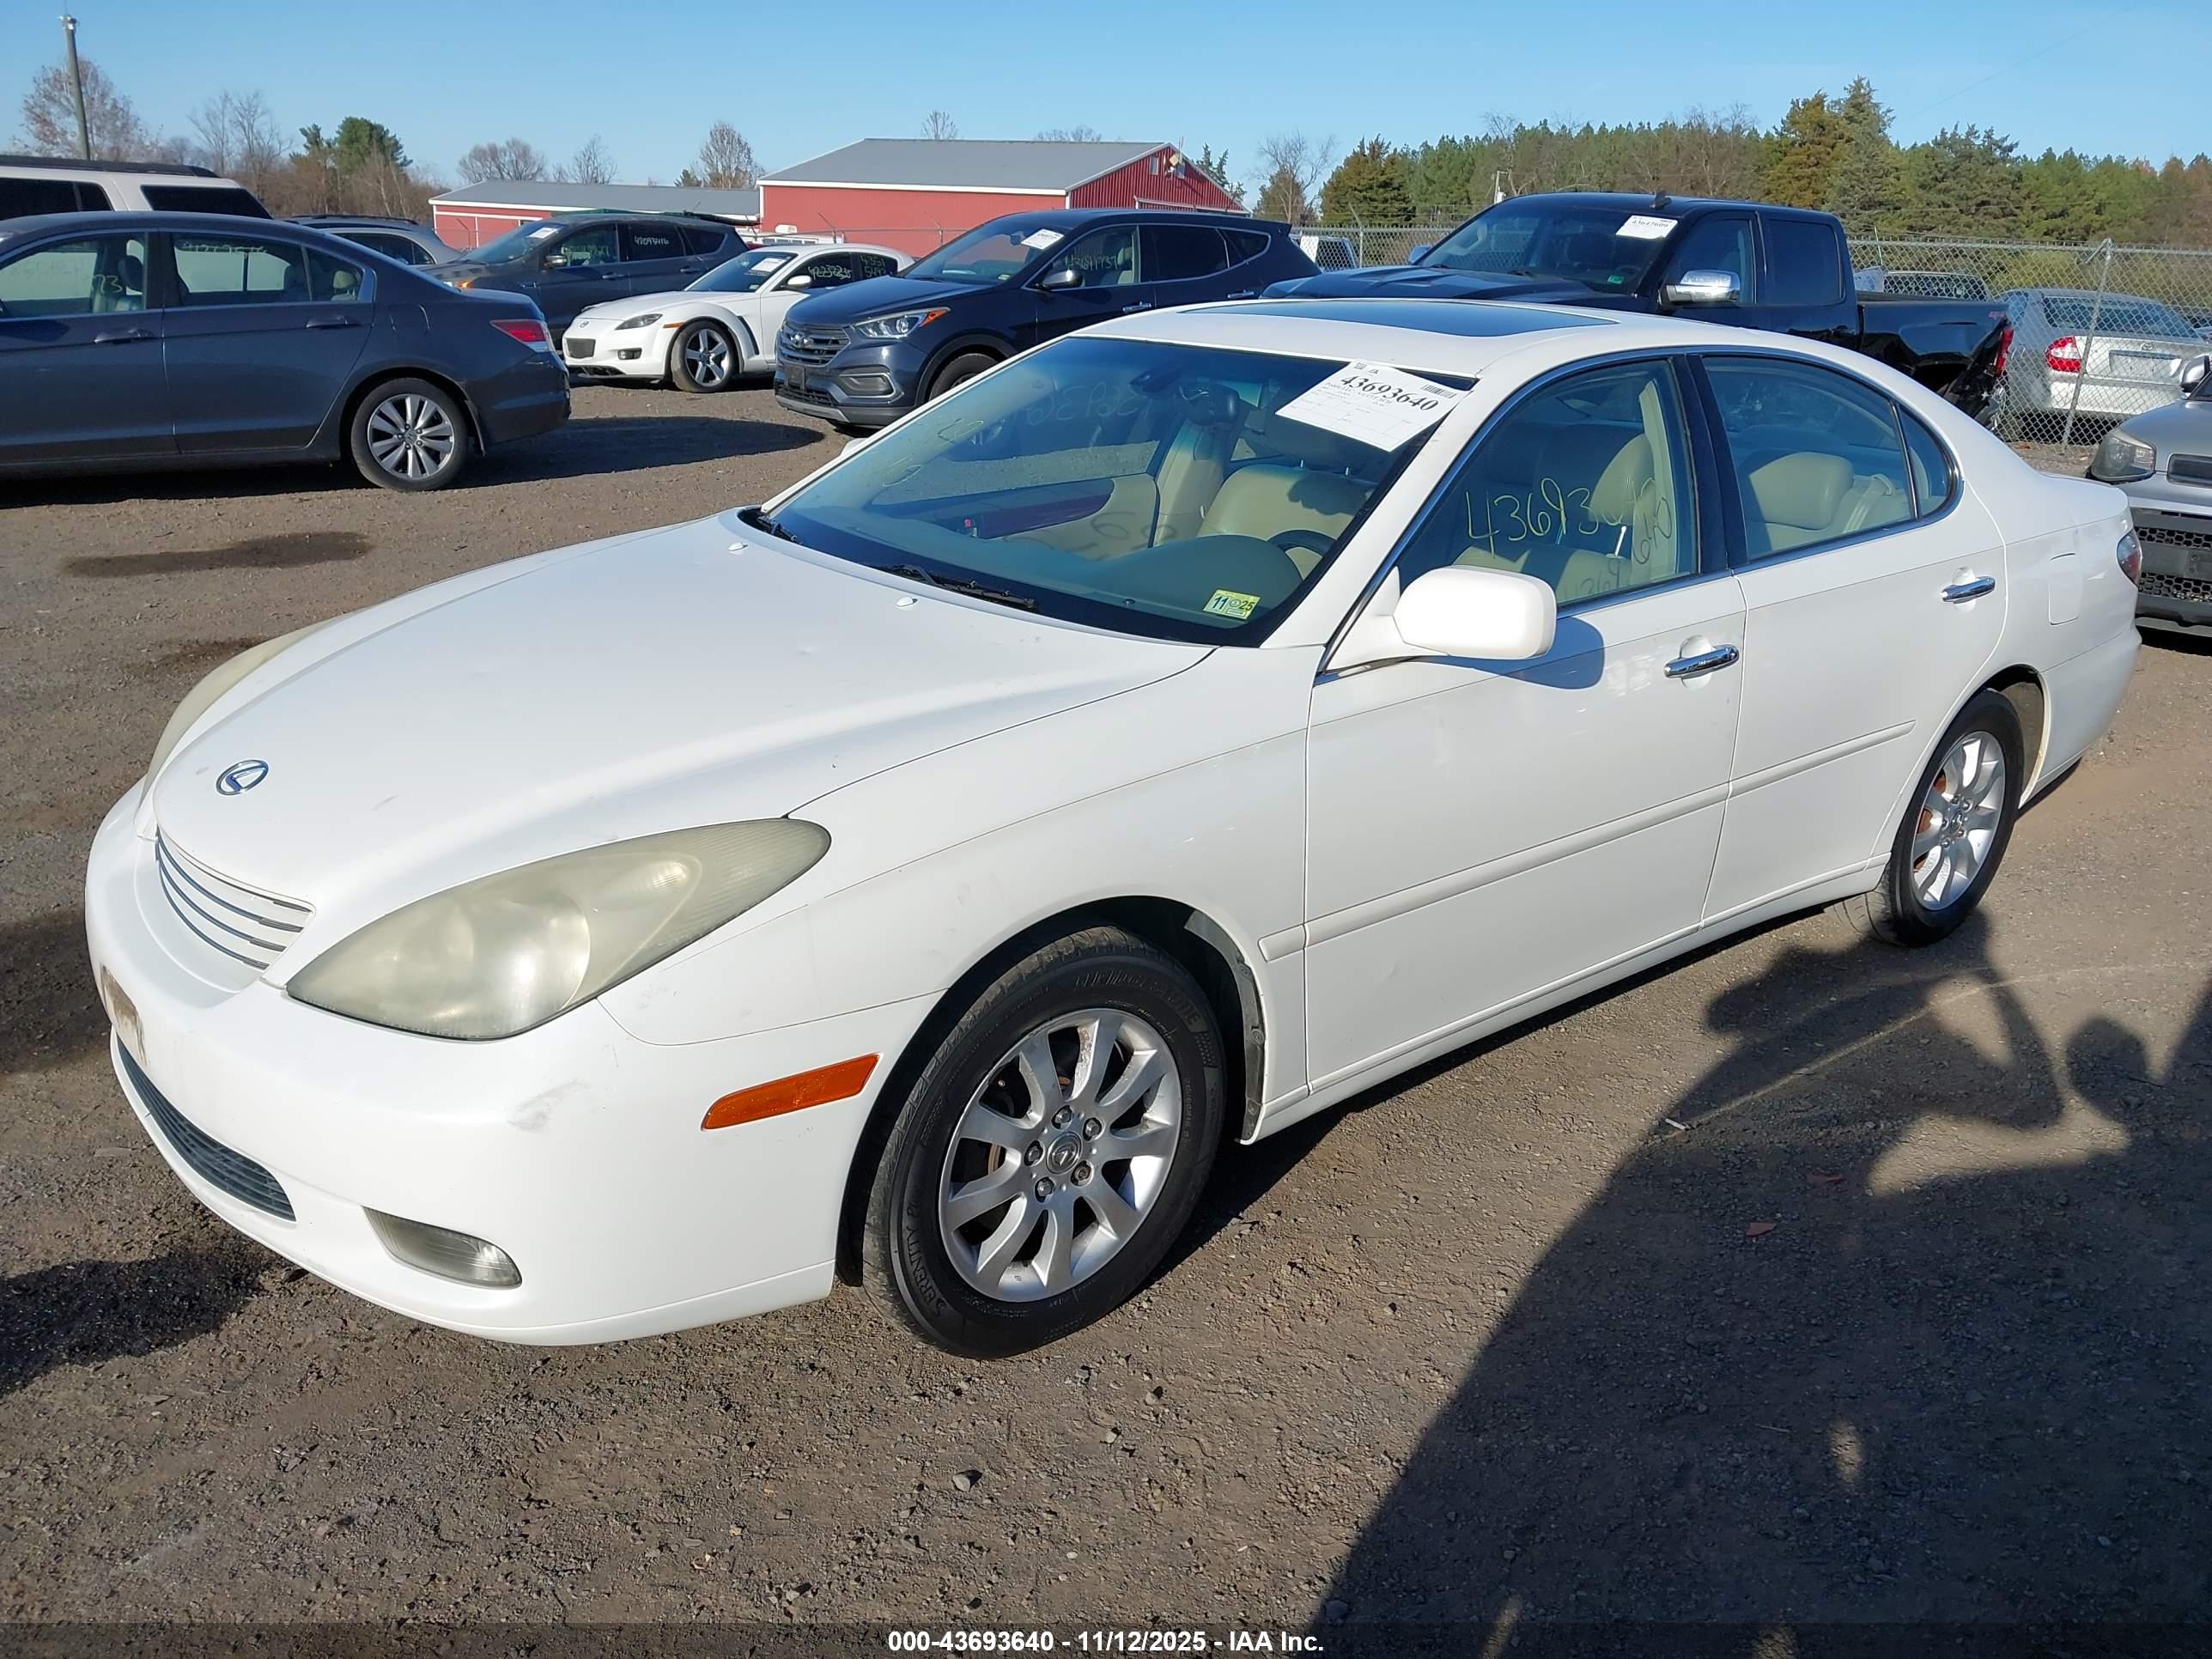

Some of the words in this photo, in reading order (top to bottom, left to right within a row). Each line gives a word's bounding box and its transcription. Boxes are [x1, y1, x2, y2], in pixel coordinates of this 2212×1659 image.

[1340, 374, 1439, 411] 43693640
[1212, 596, 1230, 610] 11
[1238, 600, 1255, 611] 25
[906, 1226, 947, 1317] SERENITY
